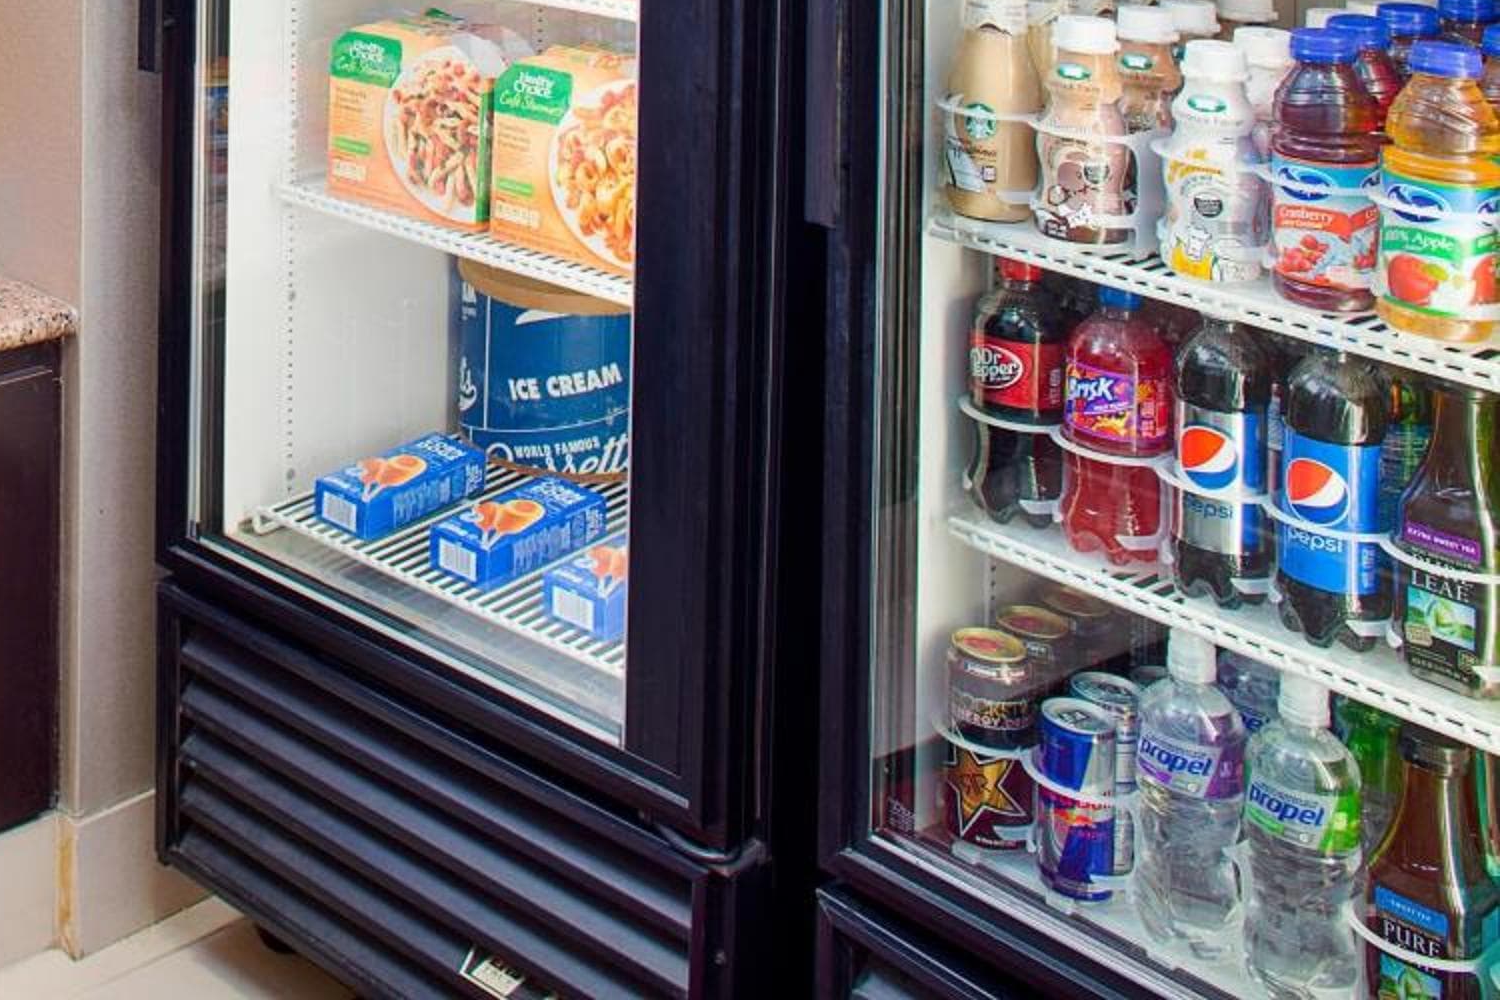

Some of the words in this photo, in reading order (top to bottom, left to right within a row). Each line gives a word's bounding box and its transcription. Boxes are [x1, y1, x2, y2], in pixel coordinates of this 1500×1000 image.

[1279, 208, 1333, 224] Cranberry
[1412, 233, 1454, 250] Apple
[984, 348, 1002, 363] Dr
[508, 378, 541, 401] ICE
[546, 362, 623, 398] CREAM
[514, 444, 551, 458] WORLD
[555, 436, 600, 455] FAMOUS
[1287, 527, 1344, 554] pepsi
[1433, 535, 1458, 549] SWEET
[1461, 544, 1476, 553] TEA
[1411, 569, 1474, 603] LEAF
[1384, 918, 1442, 957] PURE
